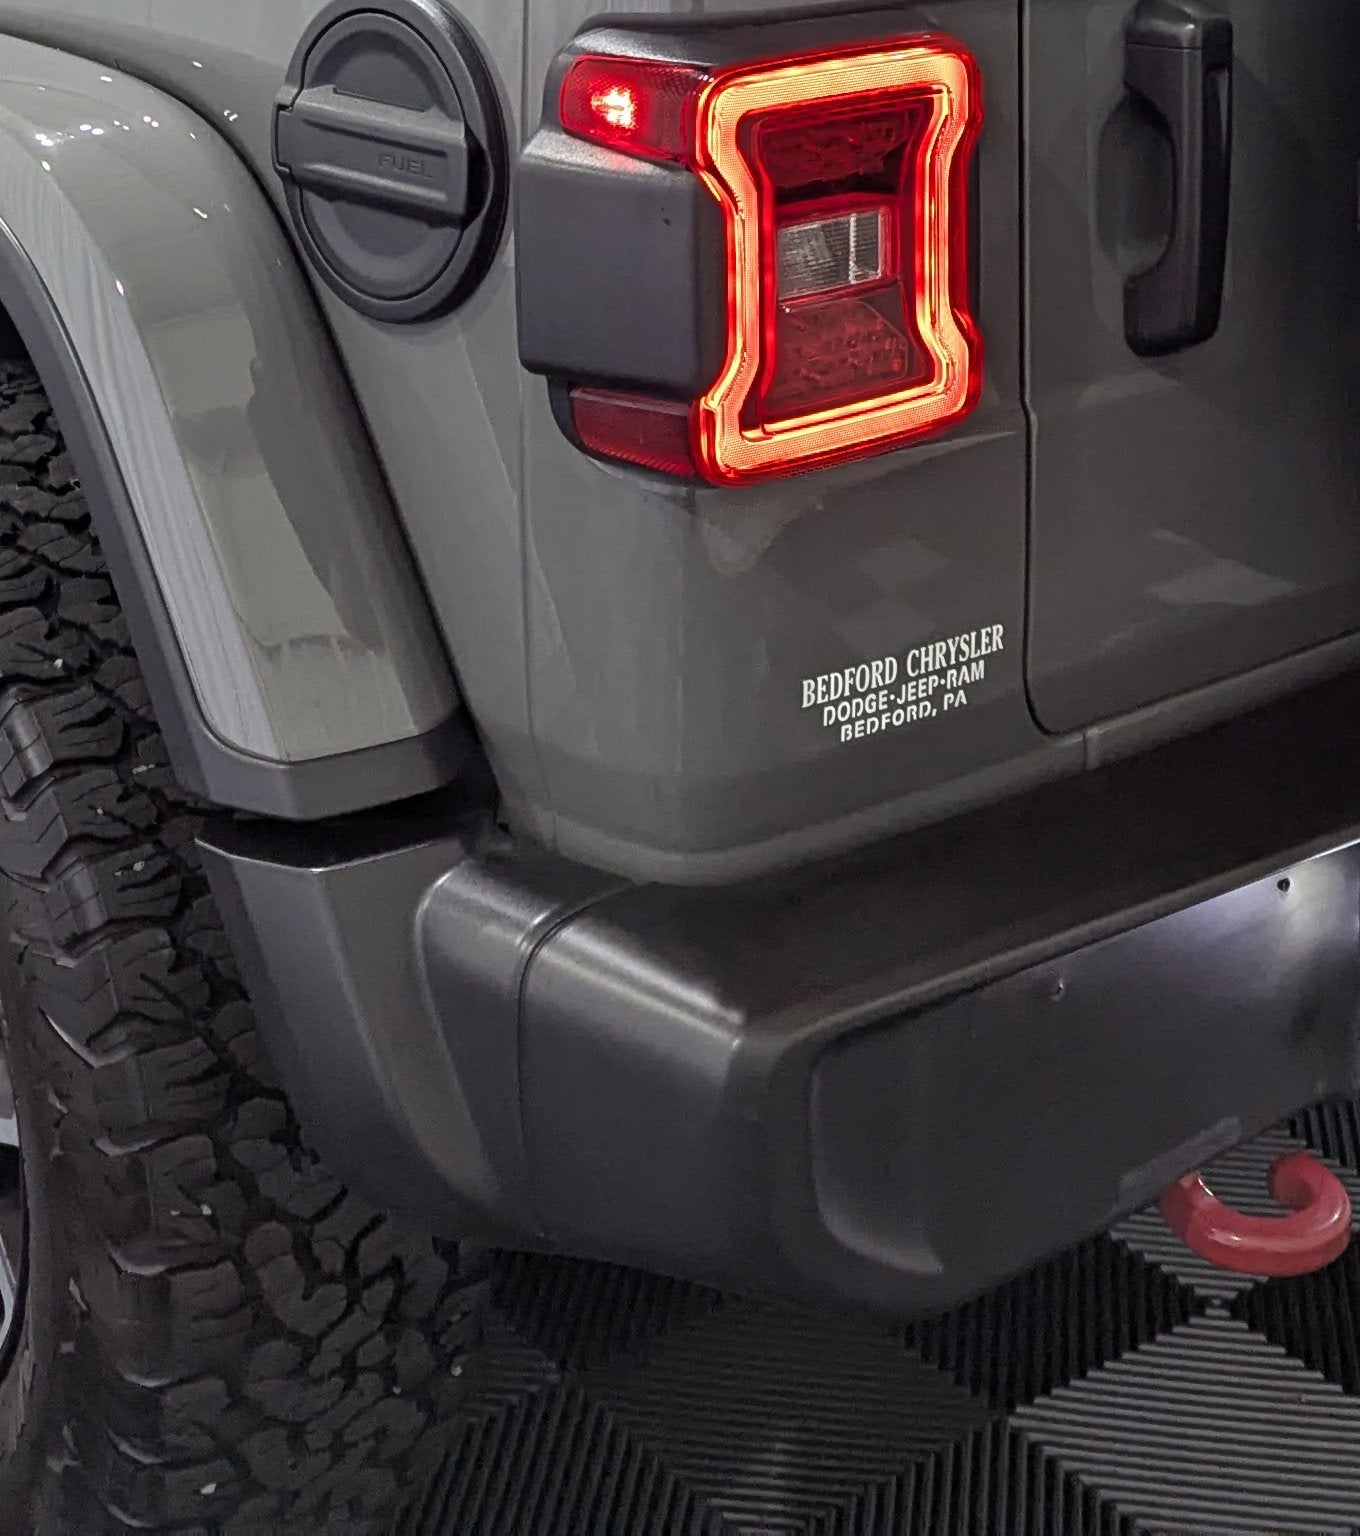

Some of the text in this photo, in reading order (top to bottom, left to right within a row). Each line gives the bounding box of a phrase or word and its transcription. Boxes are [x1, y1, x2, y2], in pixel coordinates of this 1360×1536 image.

[378, 152, 434, 179] FUEL
[801, 623, 1004, 709] BEDFORD CHRYSLER
[840, 689, 968, 743] BEDFORD, PA
